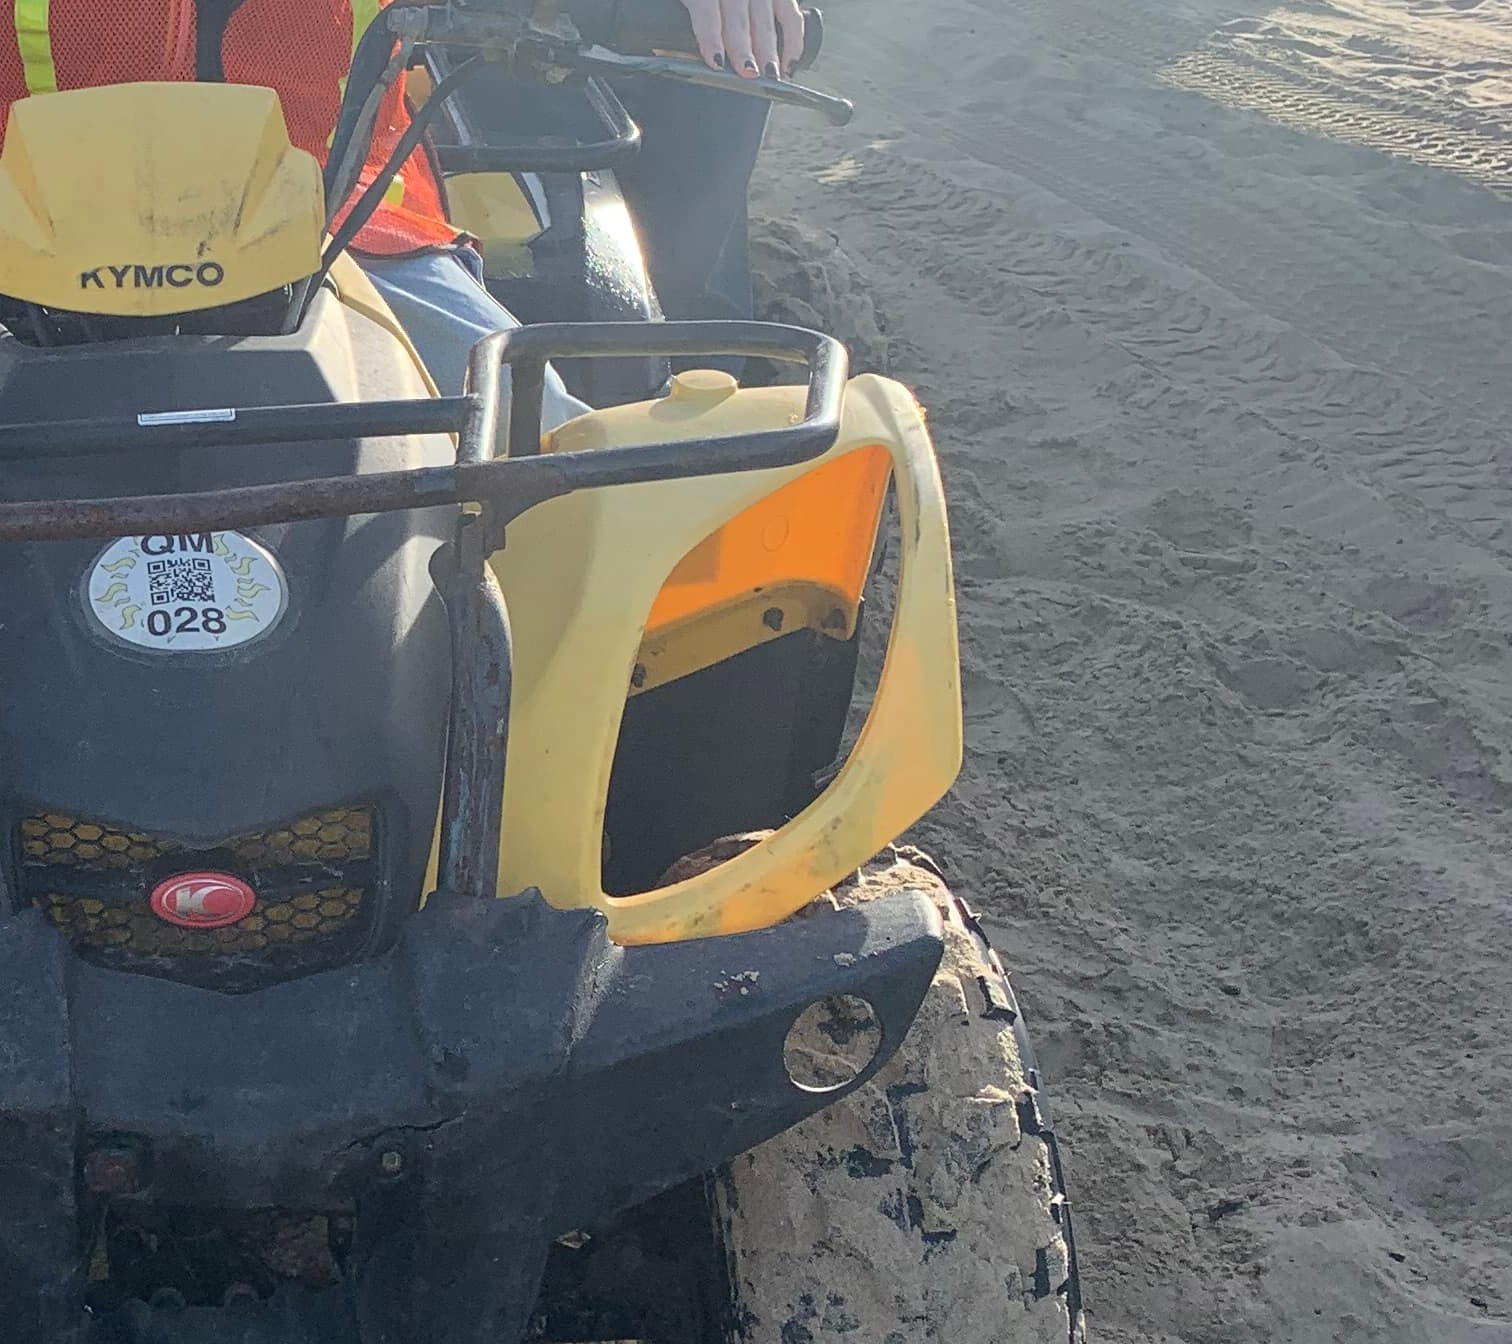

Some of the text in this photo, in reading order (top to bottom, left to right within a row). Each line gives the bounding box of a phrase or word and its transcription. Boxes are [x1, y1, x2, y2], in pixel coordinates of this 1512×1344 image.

[80, 261, 225, 289] KYMCO
[140, 532, 215, 556] QM
[146, 606, 227, 637] 028
